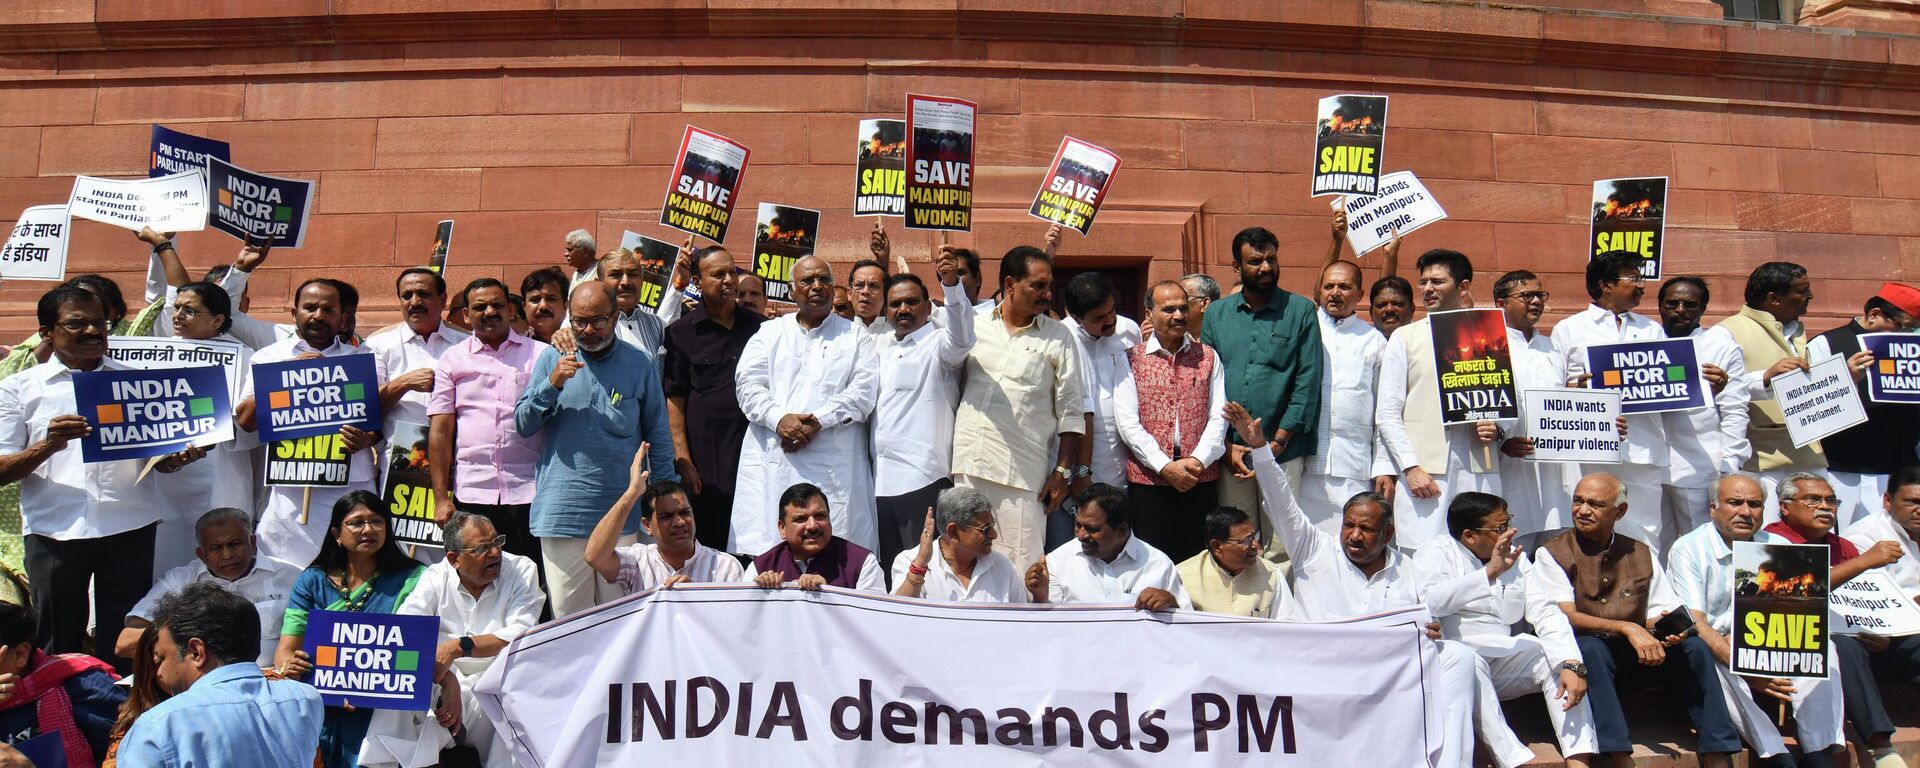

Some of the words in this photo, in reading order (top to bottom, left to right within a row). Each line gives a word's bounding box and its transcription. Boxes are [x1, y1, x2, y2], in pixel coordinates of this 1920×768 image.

[160, 142, 172, 157] PM
[1319, 146, 1375, 174] SAVE
[861, 169, 905, 195] SAVE
[914, 159, 970, 187] SAVE
[1315, 174, 1376, 193] MANIPUR
[91, 189, 123, 200] INDIA
[173, 190, 188, 198] PM
[227, 174, 282, 204] INDIA
[677, 174, 731, 208] SAVE
[909, 186, 971, 208] MANIPUR
[1050, 175, 1099, 204] SAVE
[75, 195, 137, 212] statement
[233, 195, 273, 220] FOR
[668, 193, 729, 225] MANIPUR
[1040, 190, 1094, 219] MANIPUR
[1349, 213, 1374, 231] with
[1374, 192, 1424, 219] Manipur's
[218, 204, 289, 235] MANIPUR
[669, 210, 720, 239] WOMEN
[914, 208, 969, 227] WOMEN
[1039, 204, 1086, 228] WOMEN
[1375, 213, 1416, 238] people.
[20, 220, 33, 237] के
[34, 223, 62, 238] साथ
[13, 243, 50, 263] इंडिया
[1596, 231, 1655, 257] SAVE
[1486, 356, 1496, 371] के
[1612, 349, 1671, 368] INDIA
[281, 365, 348, 387] INDIA
[1501, 369, 1510, 384] है
[1622, 367, 1665, 385] FOR
[1785, 386, 1803, 401] INDIA
[1803, 378, 1829, 395] Demand
[1829, 374, 1840, 385] PM
[111, 378, 194, 400] INDIA
[293, 385, 341, 406] FOR
[1446, 388, 1512, 412] INDIA
[1606, 383, 1689, 400] ANIPUR
[126, 400, 186, 423] FOR
[1543, 399, 1573, 412] INDIA
[1574, 401, 1606, 413] wants
[1784, 396, 1815, 418] statement
[1815, 395, 1825, 406] on
[1825, 385, 1851, 404] Manipur
[271, 403, 367, 427] MANIPUR
[1540, 417, 1596, 431] Discussion
[1599, 422, 1611, 432] on
[1799, 417, 1807, 427] in
[100, 417, 216, 445] MANIPUR
[276, 434, 347, 461] SAVE
[1531, 436, 1576, 451] Manipur
[1578, 438, 1619, 451] violence
[270, 461, 347, 482] MANIPUR
[1841, 594, 1902, 611] Manipur's
[1743, 611, 1821, 650] SAVE
[1844, 614, 1892, 629] people.
[332, 622, 404, 646] INDIA
[339, 647, 393, 670] FOR
[1737, 647, 1824, 674] MANIPUR
[314, 669, 417, 693] MANIPUR
[606, 676, 808, 743] INDIA
[830, 679, 1170, 753] demands
[1191, 692, 1297, 754] PM
